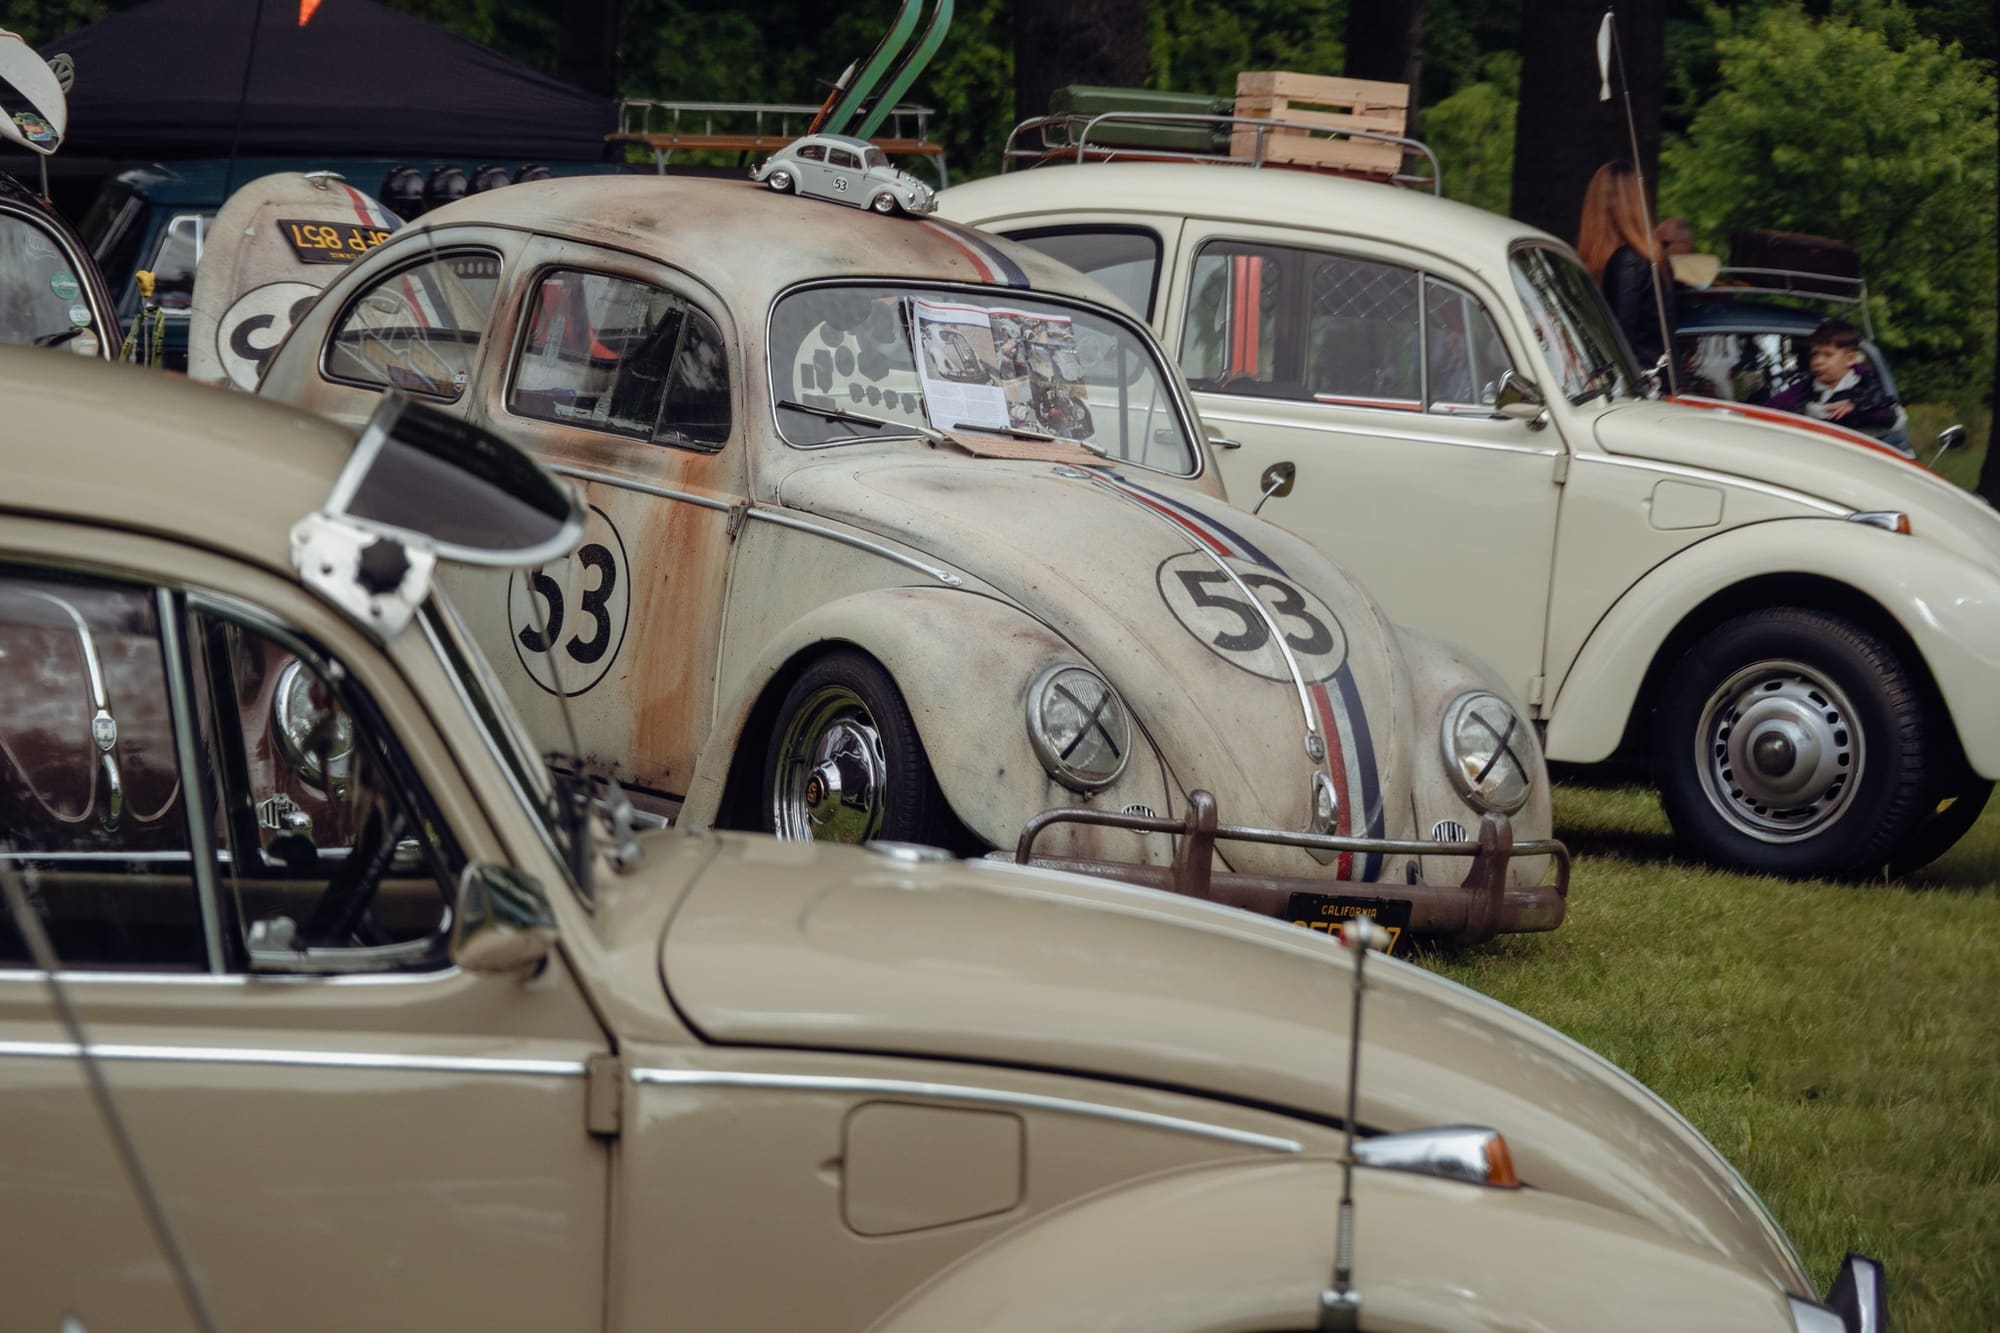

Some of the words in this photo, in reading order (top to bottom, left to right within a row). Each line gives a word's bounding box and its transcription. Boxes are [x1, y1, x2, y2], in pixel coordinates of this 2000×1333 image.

[834, 178, 848, 191] 53
[291, 224, 343, 250] 857
[518, 543, 617, 664] 53
[1174, 569, 1334, 655] 53
[1321, 904, 1377, 919] CALIFORNIA
